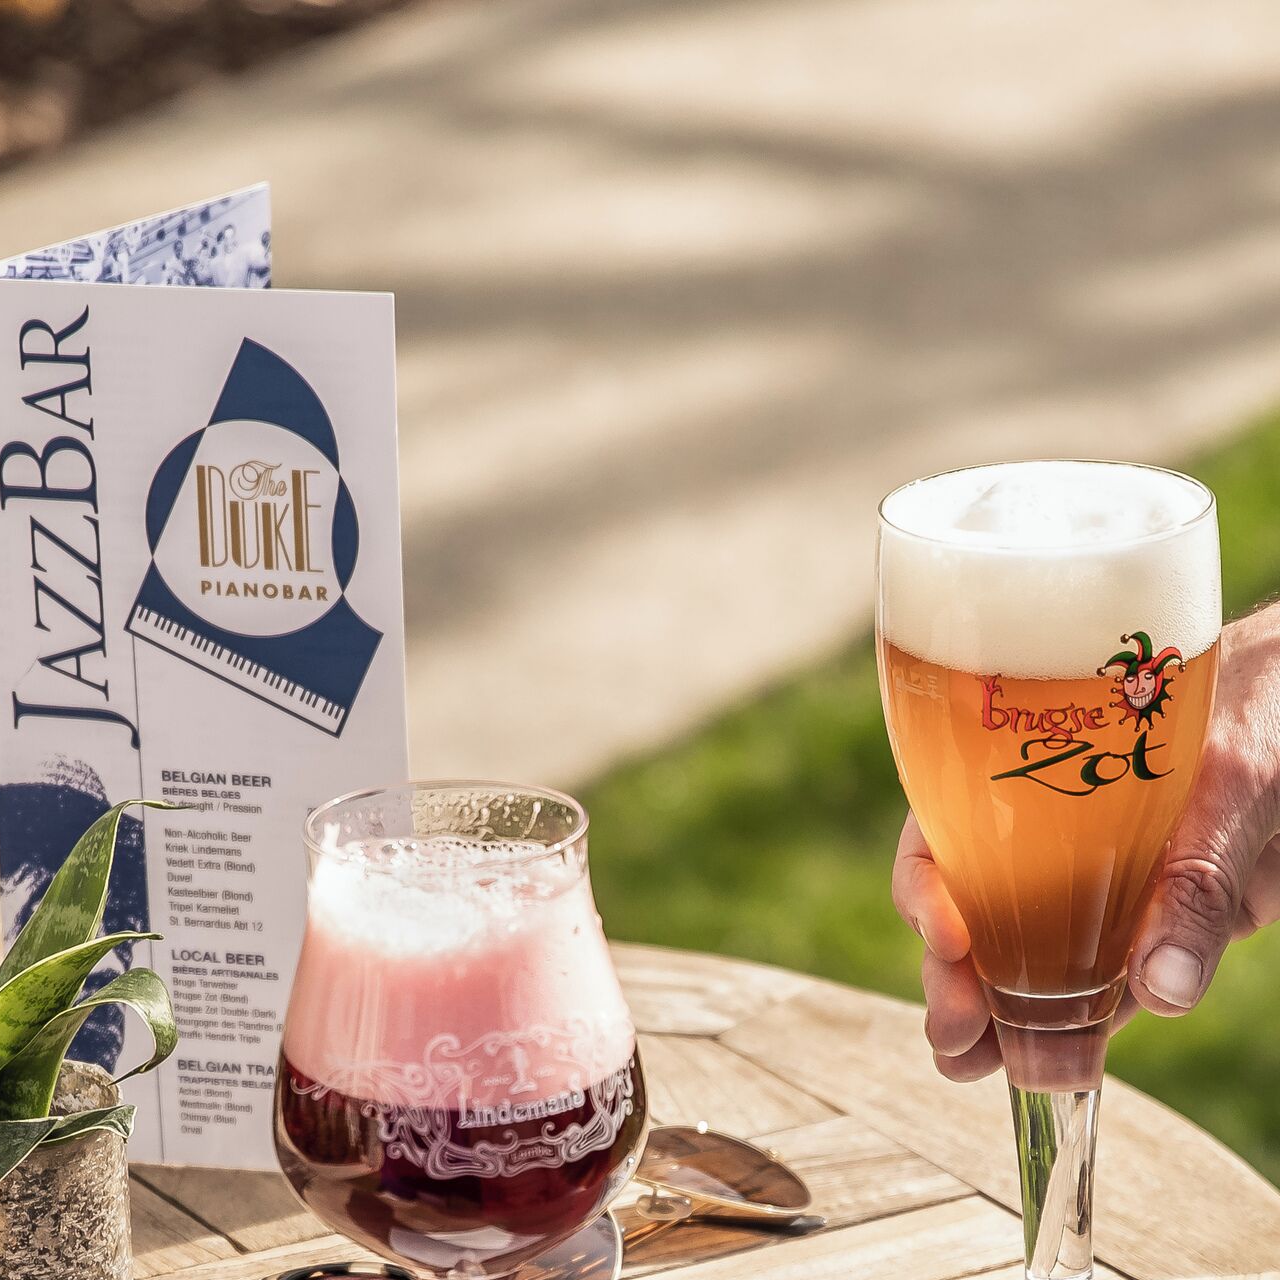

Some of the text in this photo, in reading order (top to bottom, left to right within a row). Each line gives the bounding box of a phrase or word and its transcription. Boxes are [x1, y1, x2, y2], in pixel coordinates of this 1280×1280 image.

[229, 460, 287, 501] The
[196, 465, 324, 573] DUKE
[200, 580, 329, 601] PIANOBAR
[991, 731, 1175, 796] Zot
[161, 770, 272, 788] BELGIAN BEER
[162, 785, 241, 799] BIÈRES BELGES
[223, 802, 262, 814] Pression
[164, 828, 252, 843] Non-Alcoholic Beer
[165, 843, 242, 857] Kriek Lindemans
[166, 858, 256, 873] Vedett Extra (Blond)
[167, 872, 193, 883] Duvel
[168, 887, 254, 903] Kasteelbier (Blond)
[169, 902, 240, 916] Tripel Karmeliet
[184, 917, 231, 929] Bernardus
[233, 921, 248, 931] Abt
[252, 921, 263, 932] 12
[171, 949, 265, 966] LOCAL BEER
[172, 965, 279, 981] BIÈRES ARTISANALES
[204, 992, 218, 1001] Zot
[220, 993, 249, 1005] (Blond)
[205, 1005, 218, 1014] Zot
[177, 1059, 242, 1075] BELGIAN
[177, 1075, 275, 1090] TRAPPISTES BELGE
[203, 1088, 233, 1099] (Blond)
[456, 1067, 587, 1129] Lindemans
